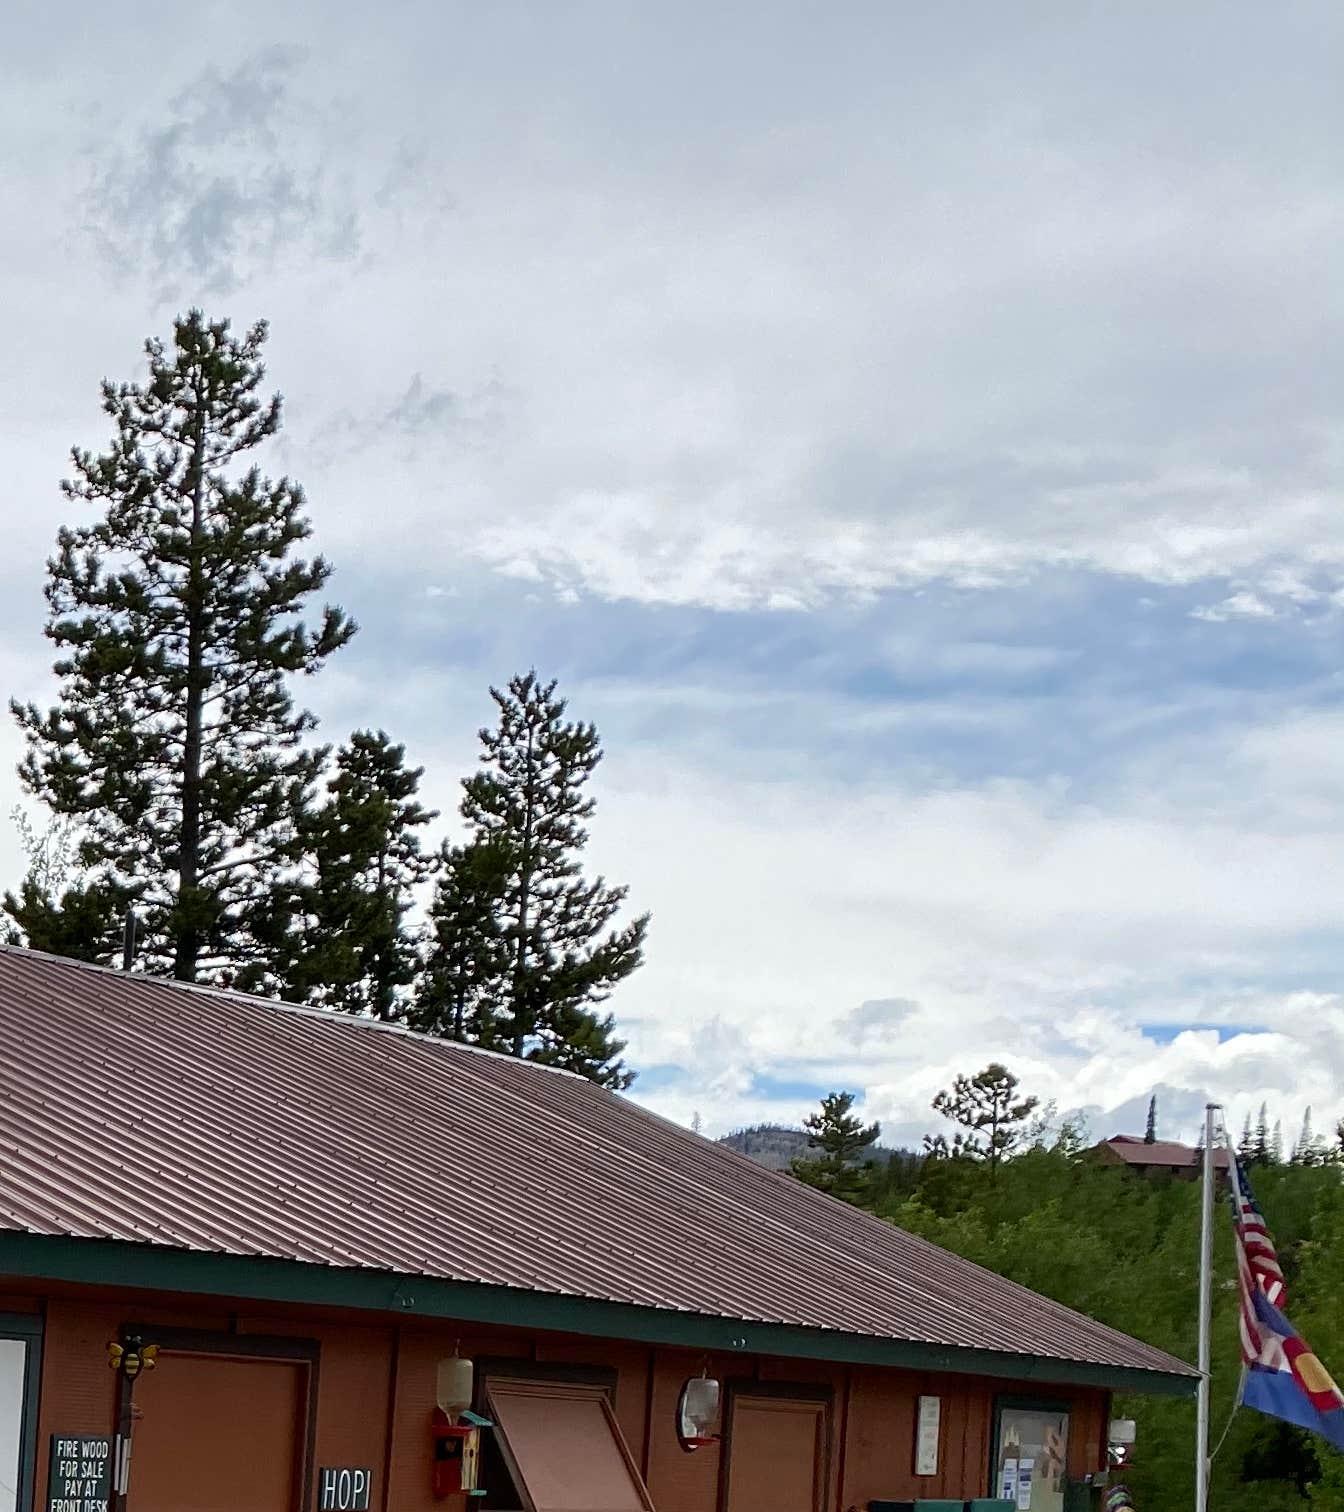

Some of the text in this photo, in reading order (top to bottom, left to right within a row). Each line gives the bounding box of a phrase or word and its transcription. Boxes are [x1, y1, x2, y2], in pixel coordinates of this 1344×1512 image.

[57, 1440, 109, 1459] FIRE WOOD
[59, 1460, 104, 1478] FOR SALE
[64, 1479, 98, 1497] PAY AT
[323, 1469, 371, 1510] HOPI
